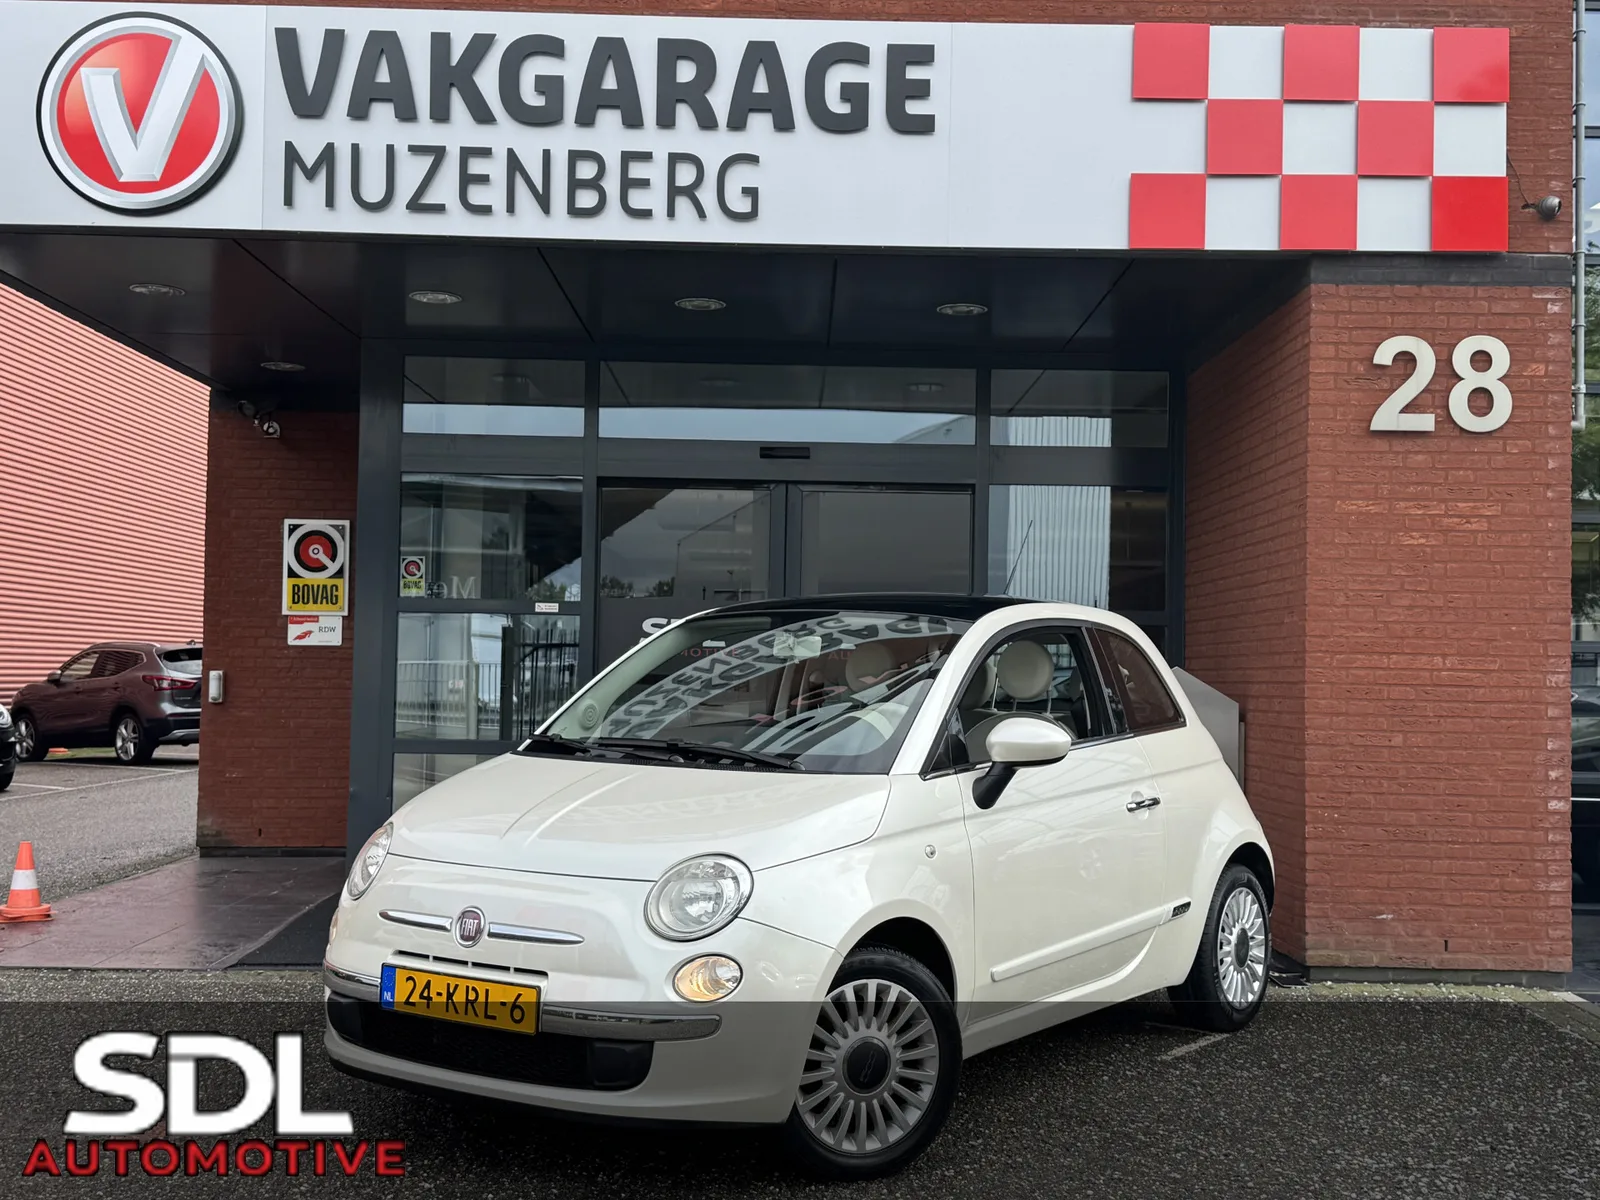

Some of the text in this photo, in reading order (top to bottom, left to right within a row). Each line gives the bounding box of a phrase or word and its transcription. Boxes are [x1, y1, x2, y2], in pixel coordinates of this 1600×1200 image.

[275, 27, 936, 134] VAKGARAGE
[282, 140, 761, 222] MUZENBERG
[1370, 335, 1513, 433] 28
[291, 583, 339, 605] BOVAG
[461, 919, 479, 936] FIAT
[384, 992, 393, 1001] NL
[403, 976, 525, 1024] 24-KRL-6
